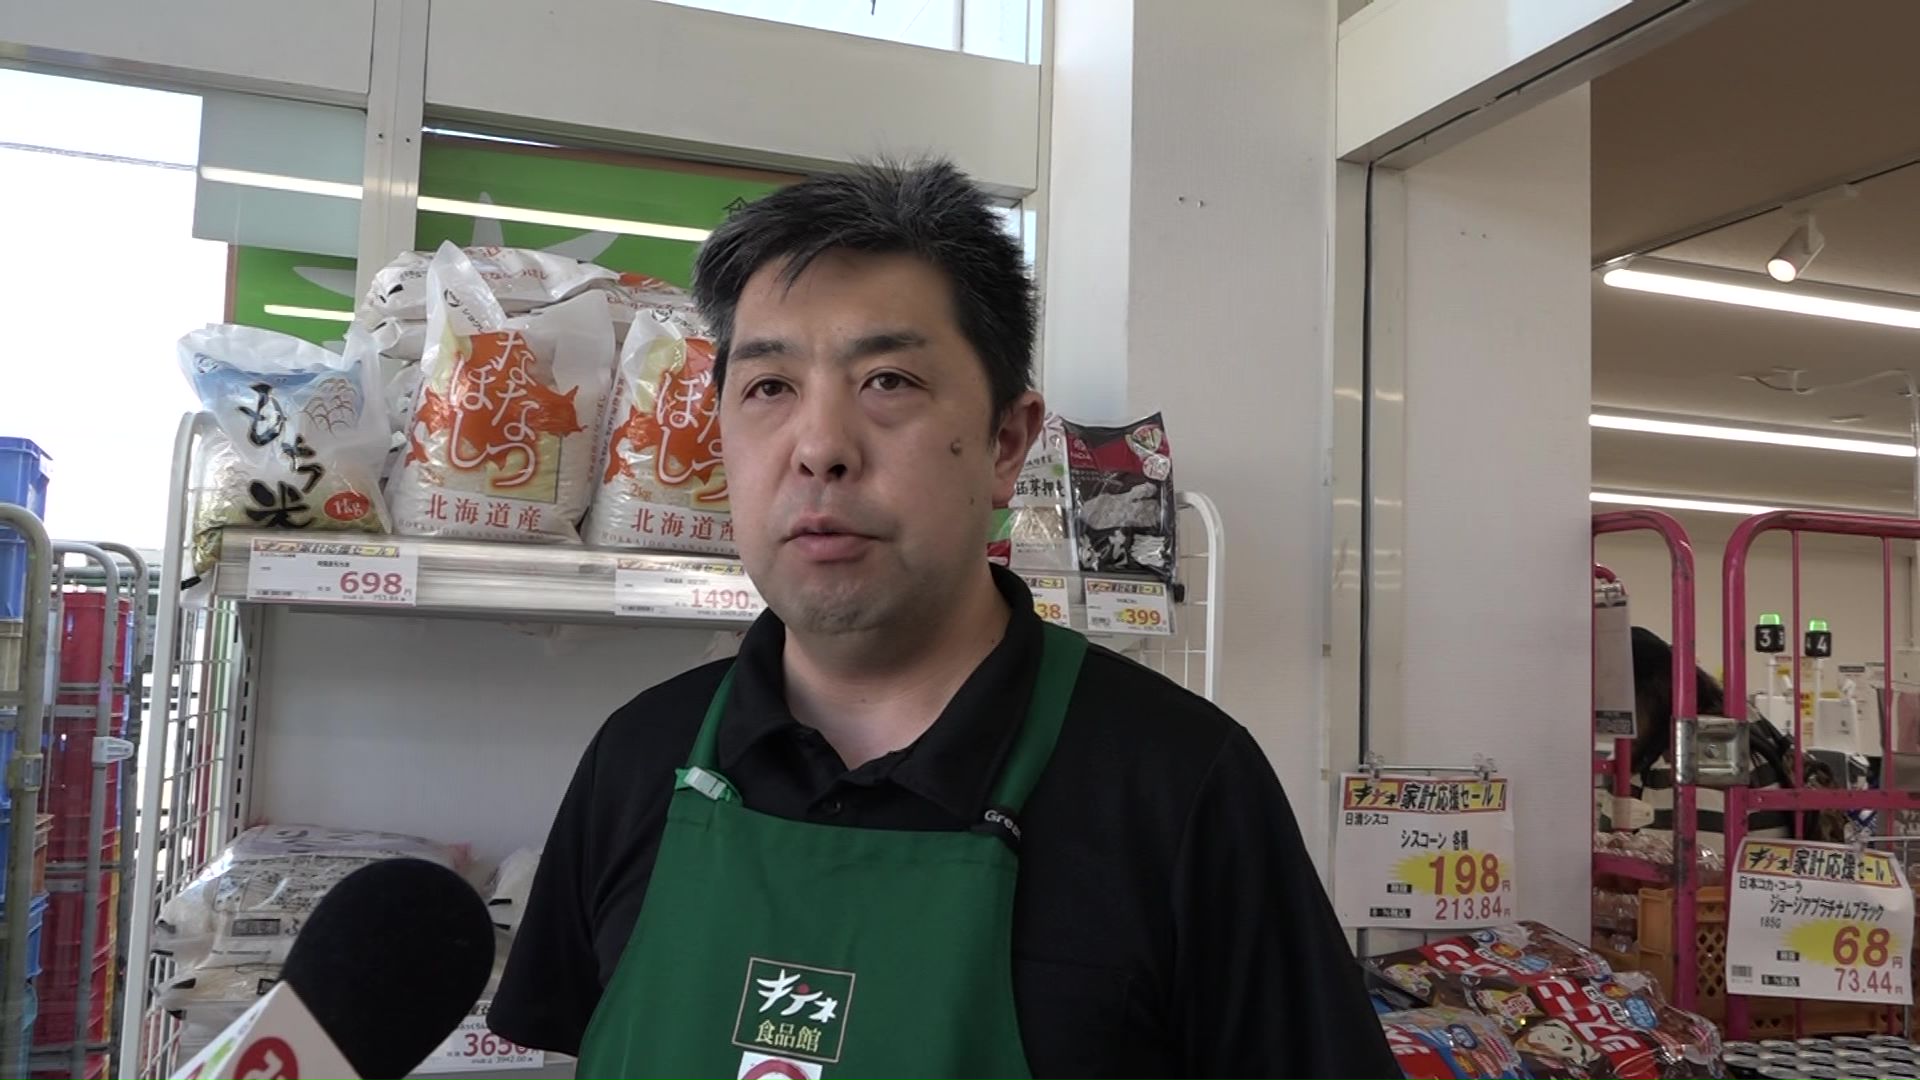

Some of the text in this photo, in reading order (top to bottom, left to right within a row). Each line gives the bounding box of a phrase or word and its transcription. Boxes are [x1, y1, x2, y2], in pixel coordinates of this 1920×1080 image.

[449, 330, 544, 487] ななつぼし
[237, 383, 326, 528] もち米
[333, 498, 364, 517] 1kg
[424, 493, 542, 533] 北海道産
[340, 570, 402, 595] 698
[691, 588, 750, 610] 1490
[1125, 608, 1161, 625] 399
[1759, 628, 1772, 648] 3
[1817, 635, 1828, 653] 4
[1345, 813, 1389, 826] 日清シスコ
[1401, 829, 1447, 850] シスコーン
[1429, 854, 1500, 896] 198
[1502, 879, 1512, 892] 円
[1435, 896, 1502, 921] 213.84
[1833, 925, 1892, 968] 68
[1892, 956, 1904, 970] 円
[1834, 968, 1893, 994] 73.44
[755, 1020, 822, 1053] 食品館
